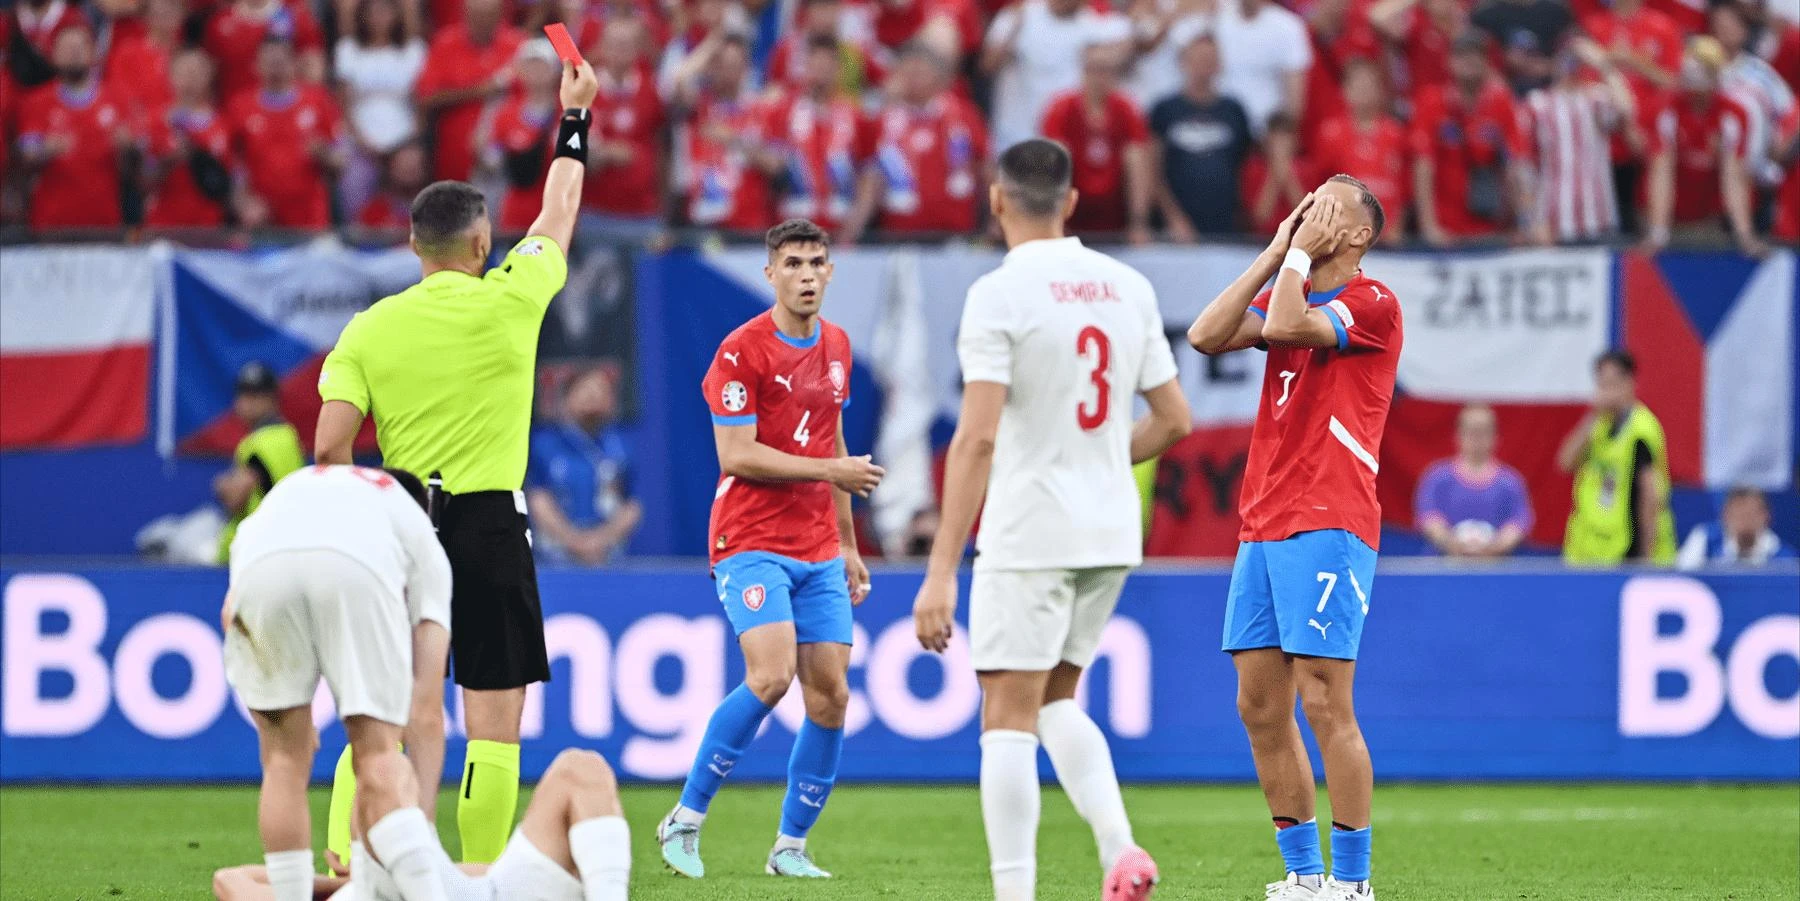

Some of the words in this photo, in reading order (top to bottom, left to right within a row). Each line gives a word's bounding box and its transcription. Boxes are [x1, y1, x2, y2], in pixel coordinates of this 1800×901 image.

[1076, 325, 1112, 432] 3
[1276, 370, 1296, 407] 7
[793, 410, 810, 448] 4
[1316, 571, 1338, 613] 7
